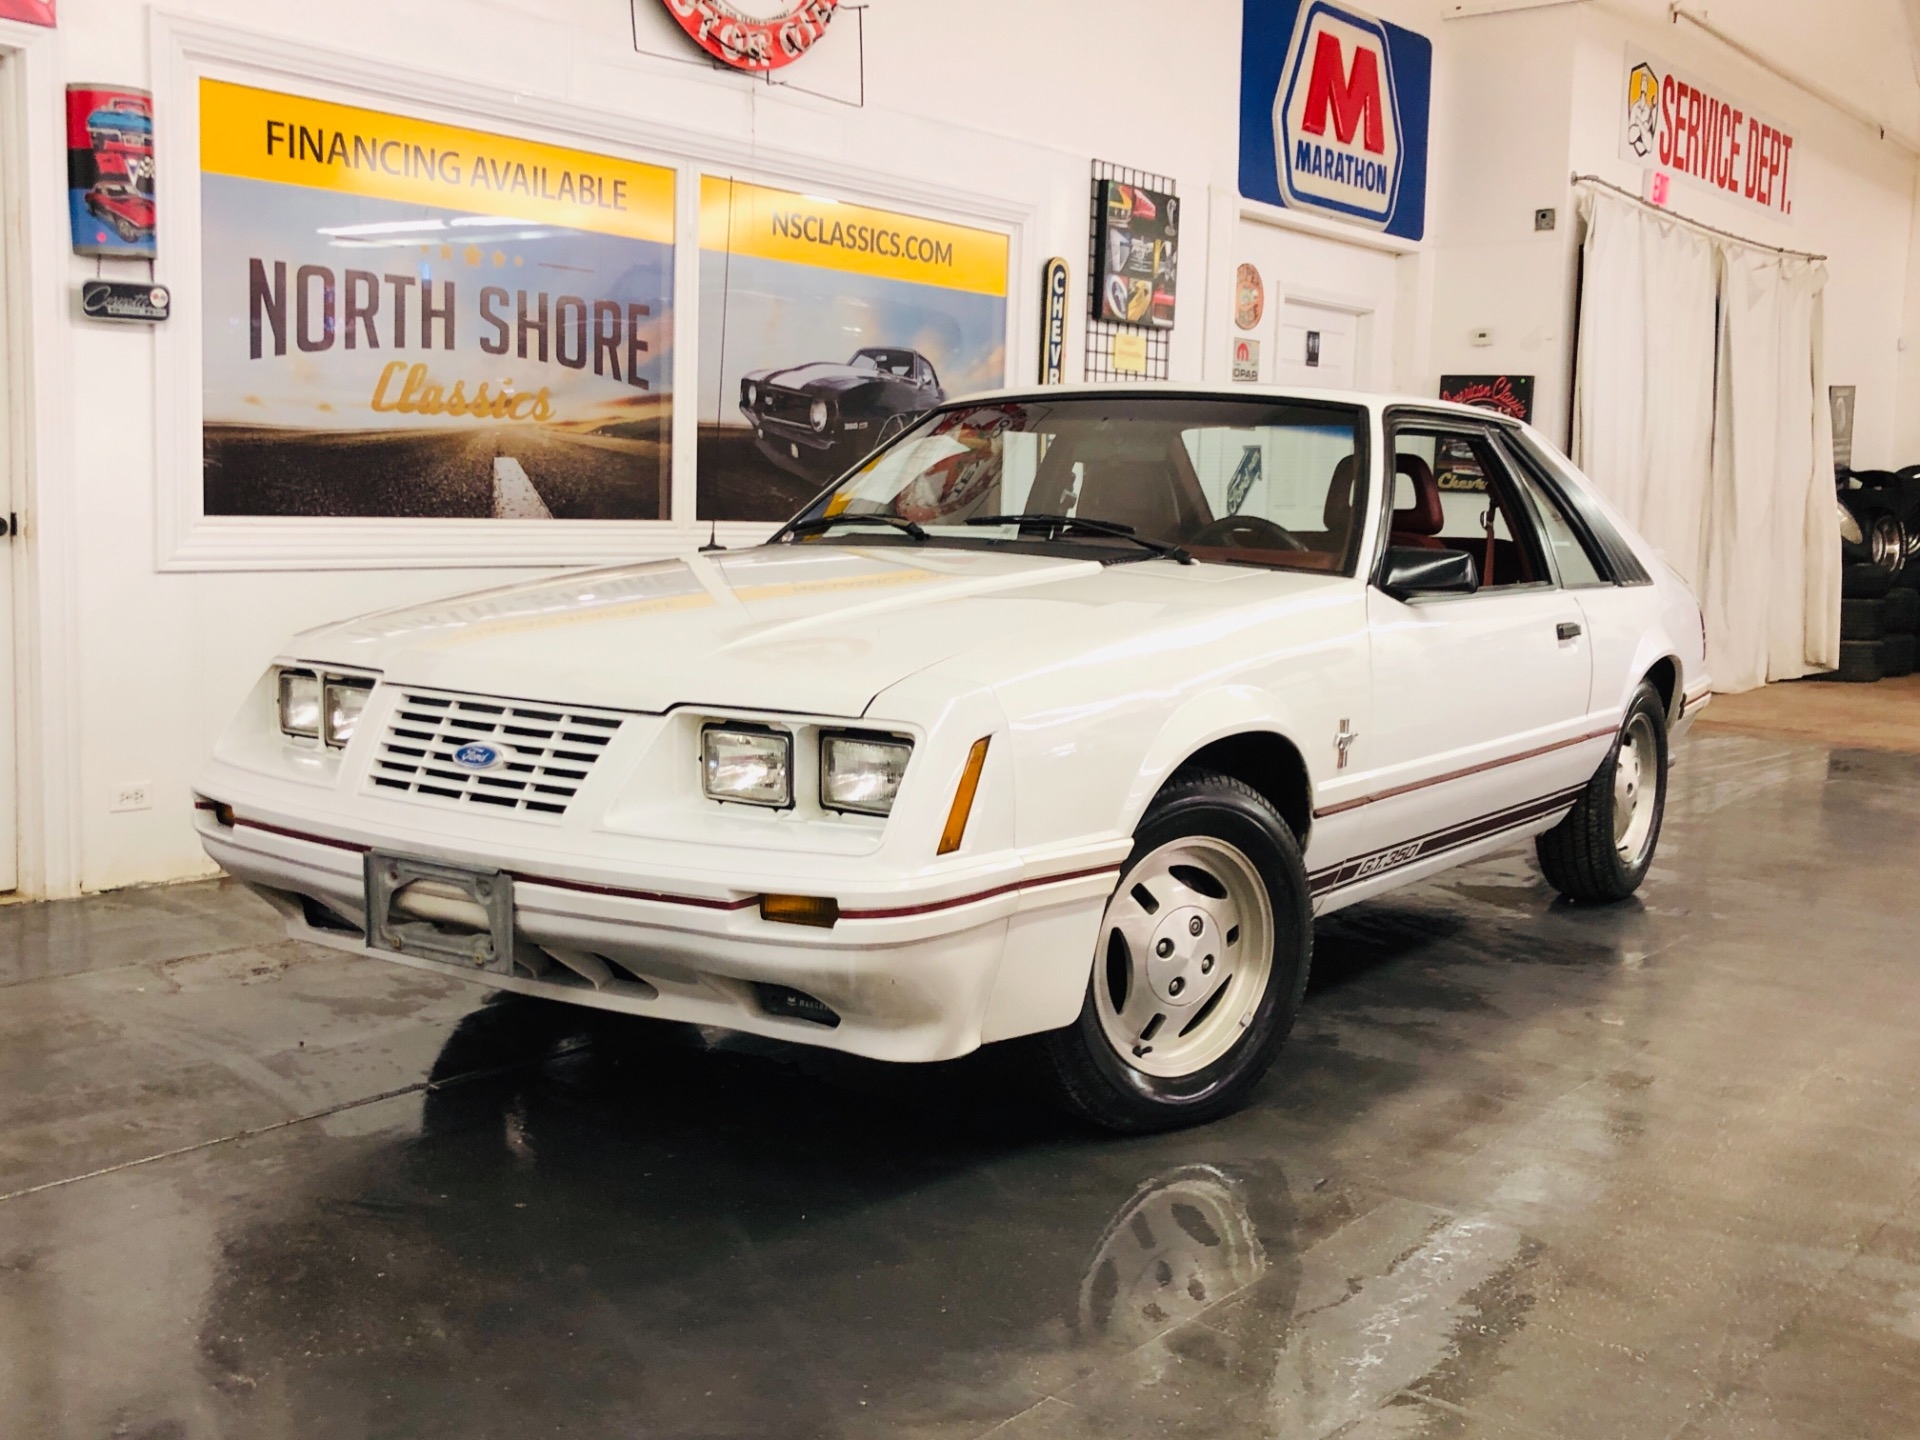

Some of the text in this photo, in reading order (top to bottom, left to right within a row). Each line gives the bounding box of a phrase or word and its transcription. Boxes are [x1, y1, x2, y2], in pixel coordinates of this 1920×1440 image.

[1302, 29, 1385, 155] M
[266, 121, 628, 213] FINANCING AVAILABLE
[1294, 139, 1387, 196] MARATHON
[1659, 74, 1793, 215] SERVICE DEPT.
[771, 211, 953, 268] NSCLASSICS.COM
[249, 258, 652, 390] NORTH SHORE
[371, 361, 557, 422] Classics
[1232, 368, 1258, 379] OPAR
